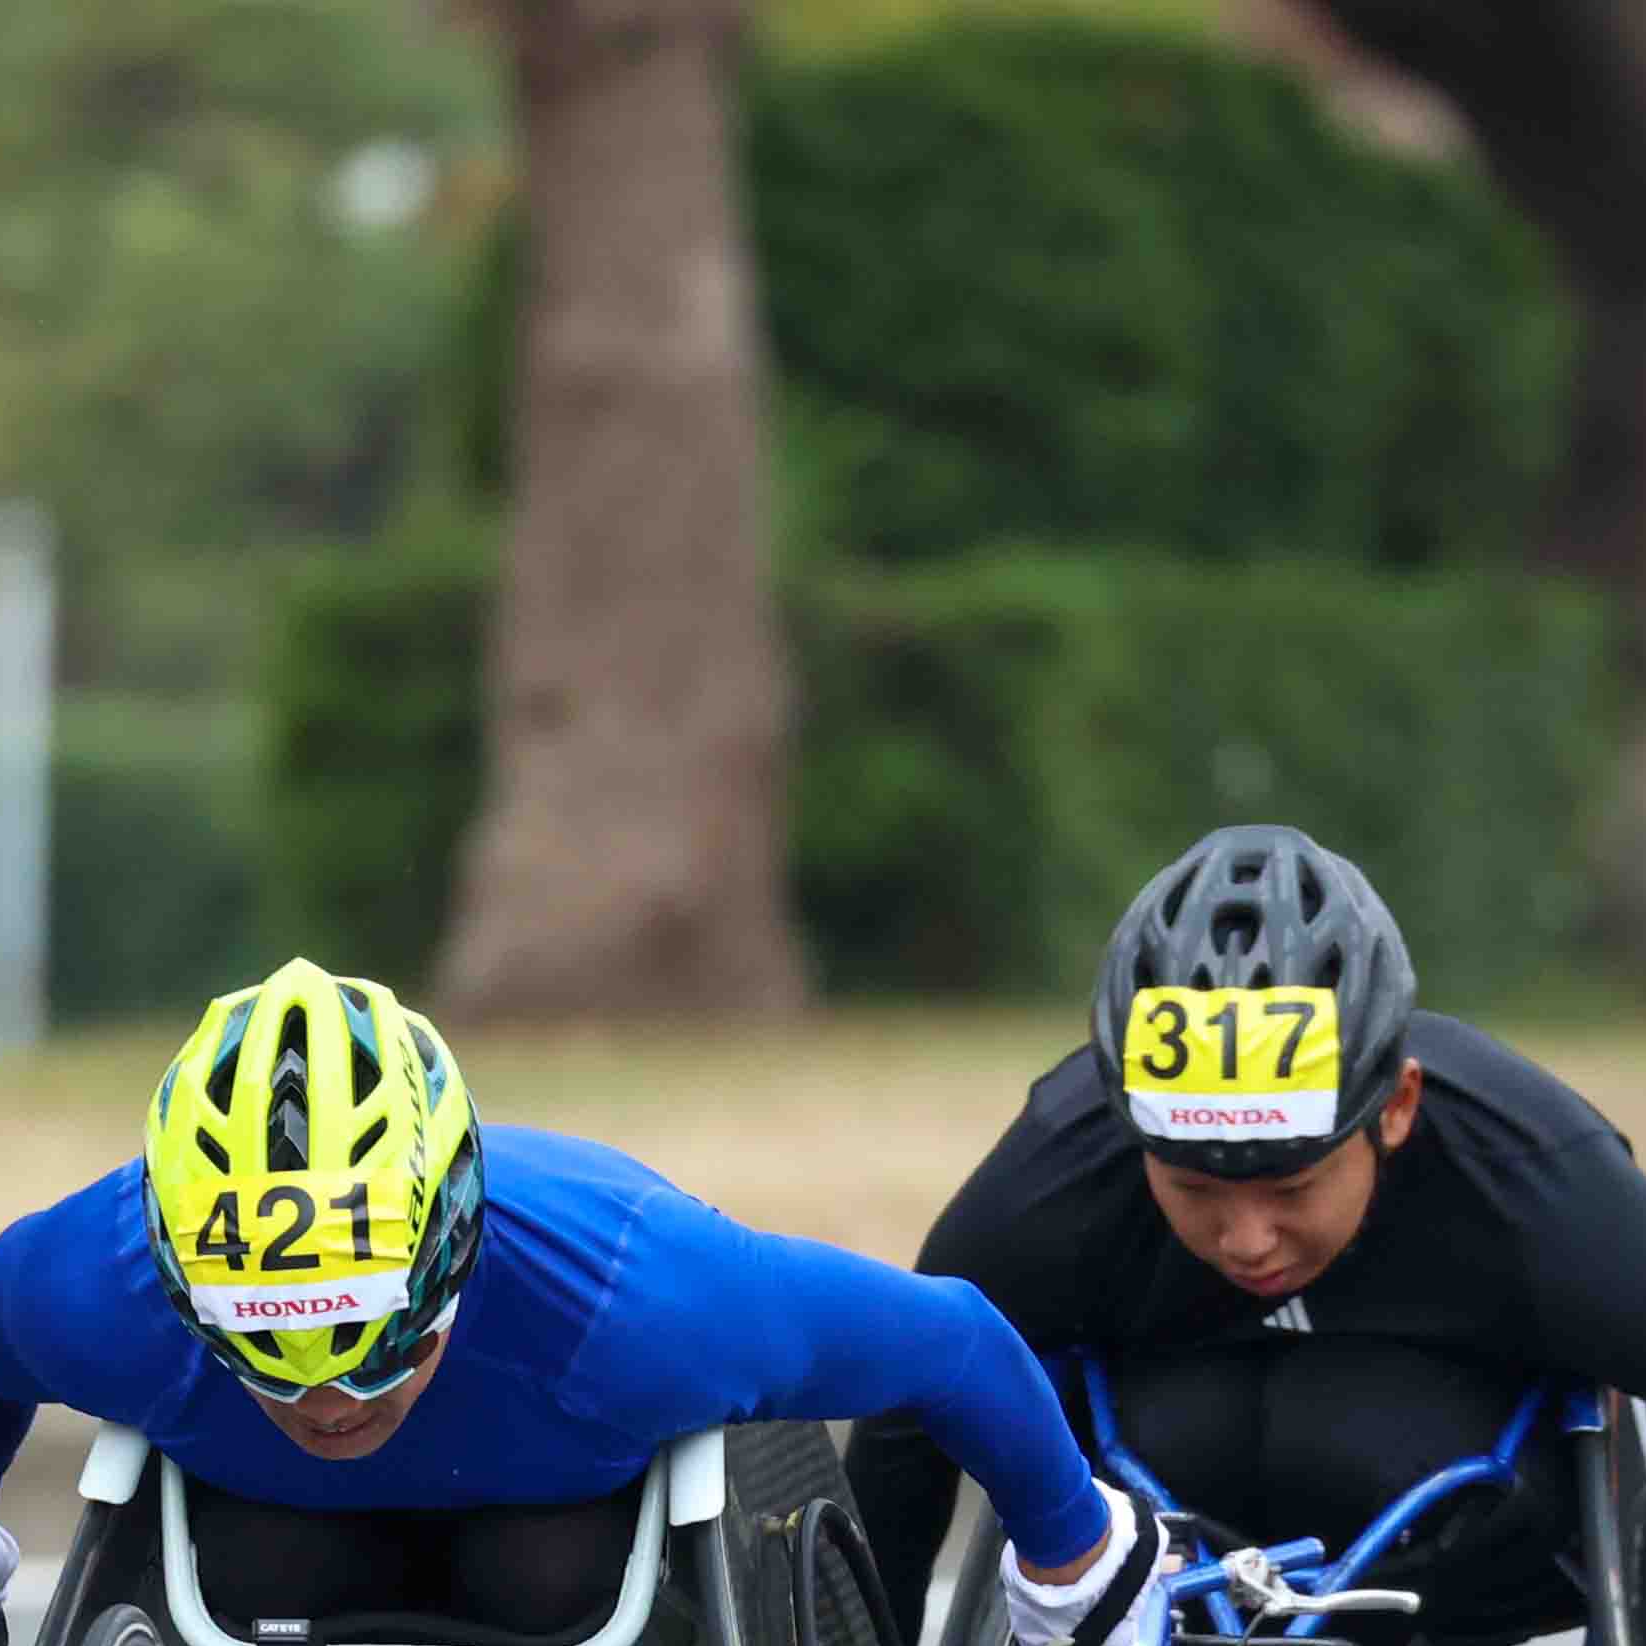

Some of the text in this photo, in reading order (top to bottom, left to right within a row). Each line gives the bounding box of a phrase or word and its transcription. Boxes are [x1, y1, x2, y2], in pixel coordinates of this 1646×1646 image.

[1141, 1000, 1315, 1081] 317
[1169, 1107, 1288, 1126] HONDA
[195, 1182, 374, 1272] 421
[232, 1292, 361, 1318] HONDA
